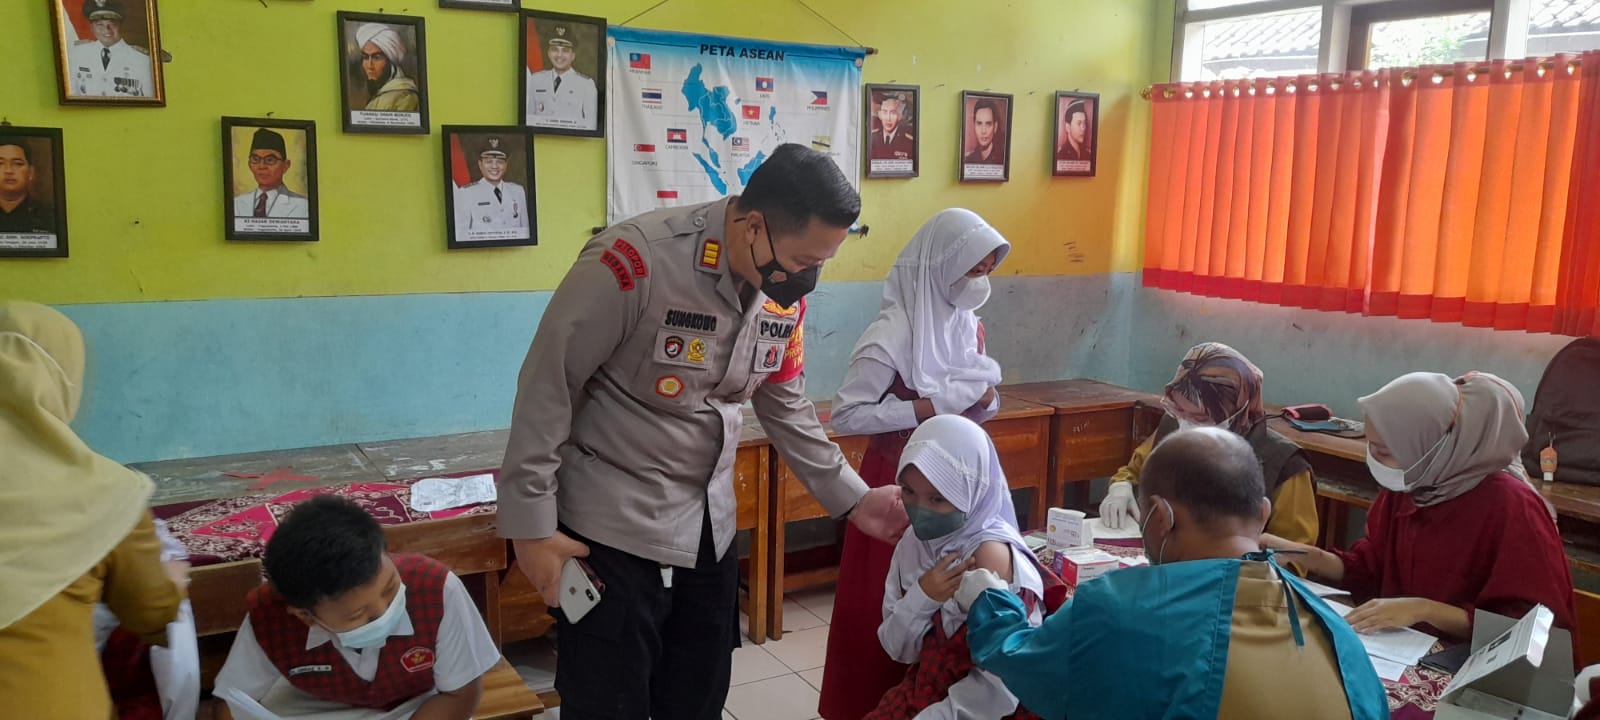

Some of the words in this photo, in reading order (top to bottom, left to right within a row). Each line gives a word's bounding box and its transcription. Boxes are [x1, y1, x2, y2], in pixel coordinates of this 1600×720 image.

[700, 44, 735, 57] PETA
[740, 47, 784, 61] ASEAN
[665, 309, 717, 331] SUNGKOWO
